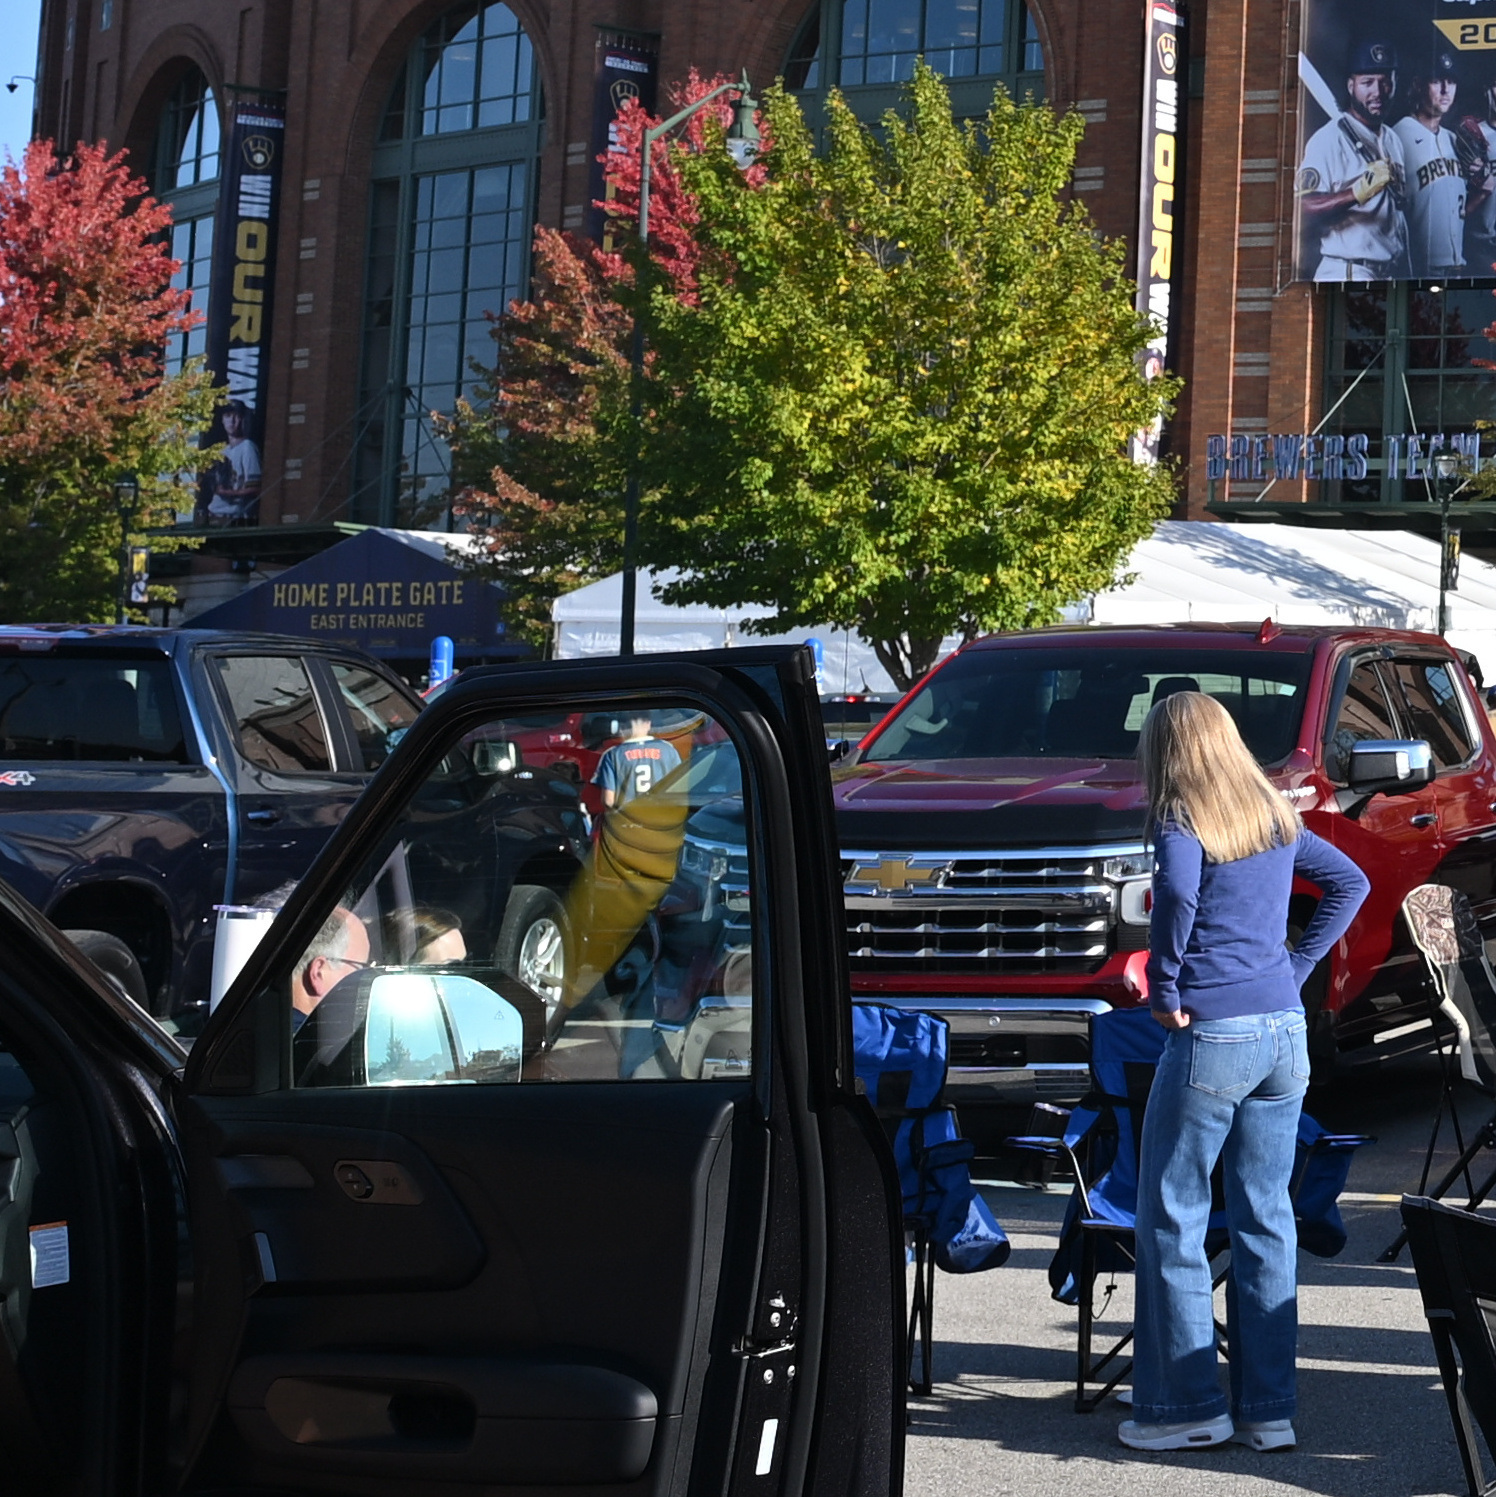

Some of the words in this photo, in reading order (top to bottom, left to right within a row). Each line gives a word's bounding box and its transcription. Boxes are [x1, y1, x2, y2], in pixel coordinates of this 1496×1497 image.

[238, 174, 272, 219] WIN
[1150, 132, 1176, 280] OUR
[229, 220, 268, 344] OUR
[226, 346, 261, 410] WAY
[1206, 433, 1369, 481] BREWERS
[273, 583, 328, 607] HOME
[336, 582, 402, 607] PLATE
[409, 580, 464, 605] GATE
[310, 614, 345, 630] EAST
[350, 613, 424, 629] ENTRANCE
